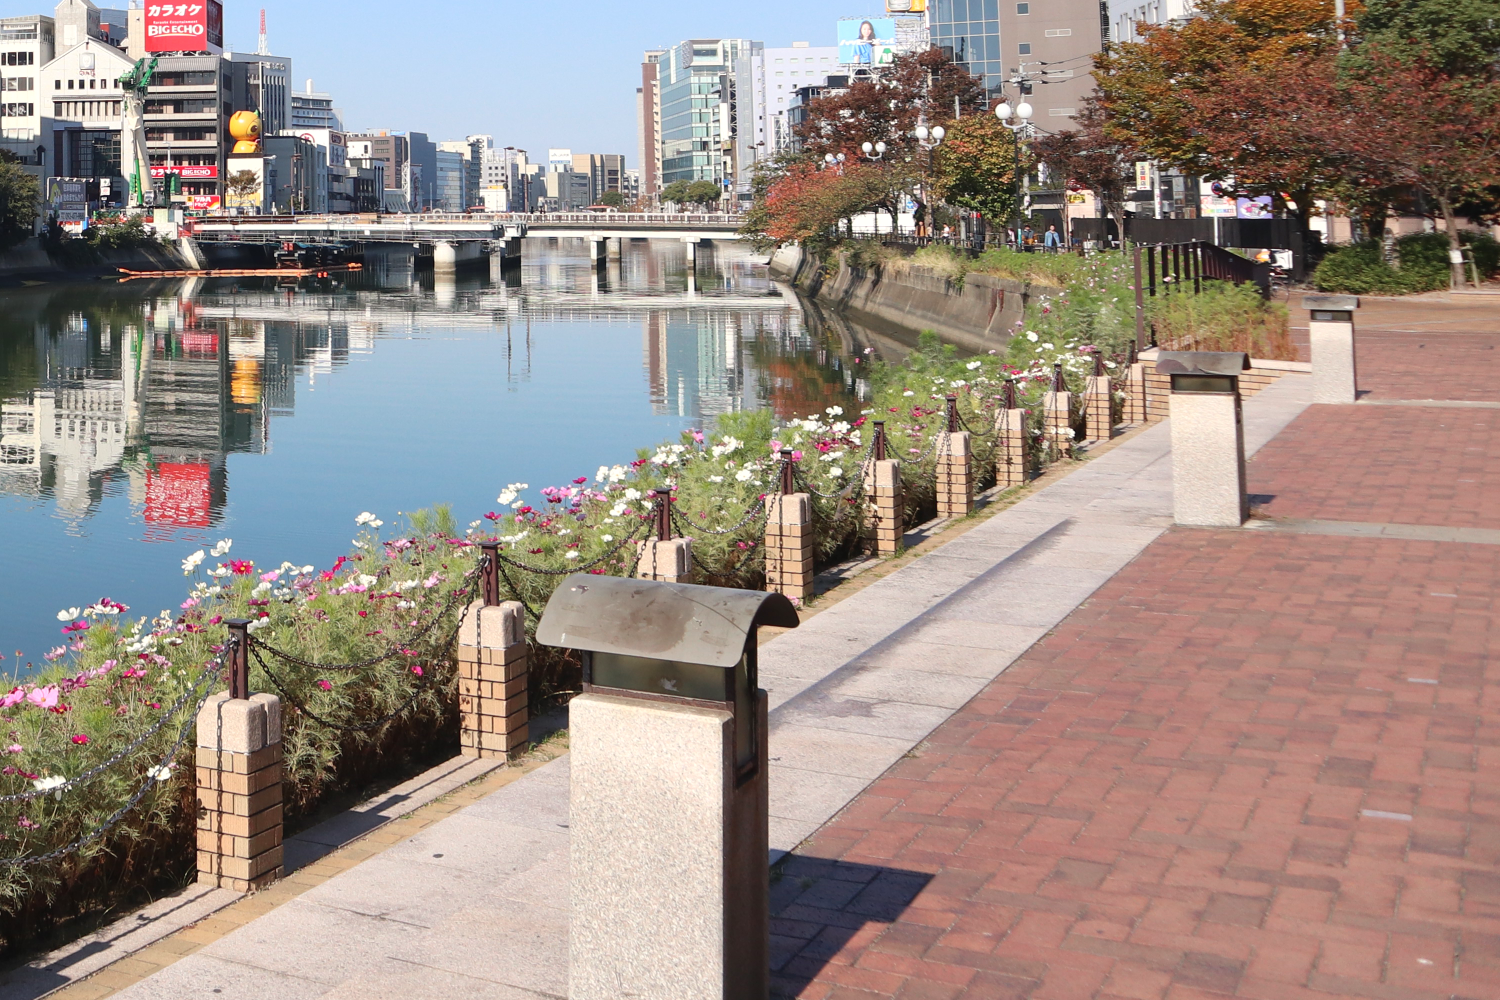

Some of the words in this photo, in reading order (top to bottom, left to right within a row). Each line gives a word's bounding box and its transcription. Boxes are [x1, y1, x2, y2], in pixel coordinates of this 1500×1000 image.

[148, 4, 203, 17] カラオケ
[148, 25, 171, 37] BIG
[171, 24, 204, 35] ECHO
